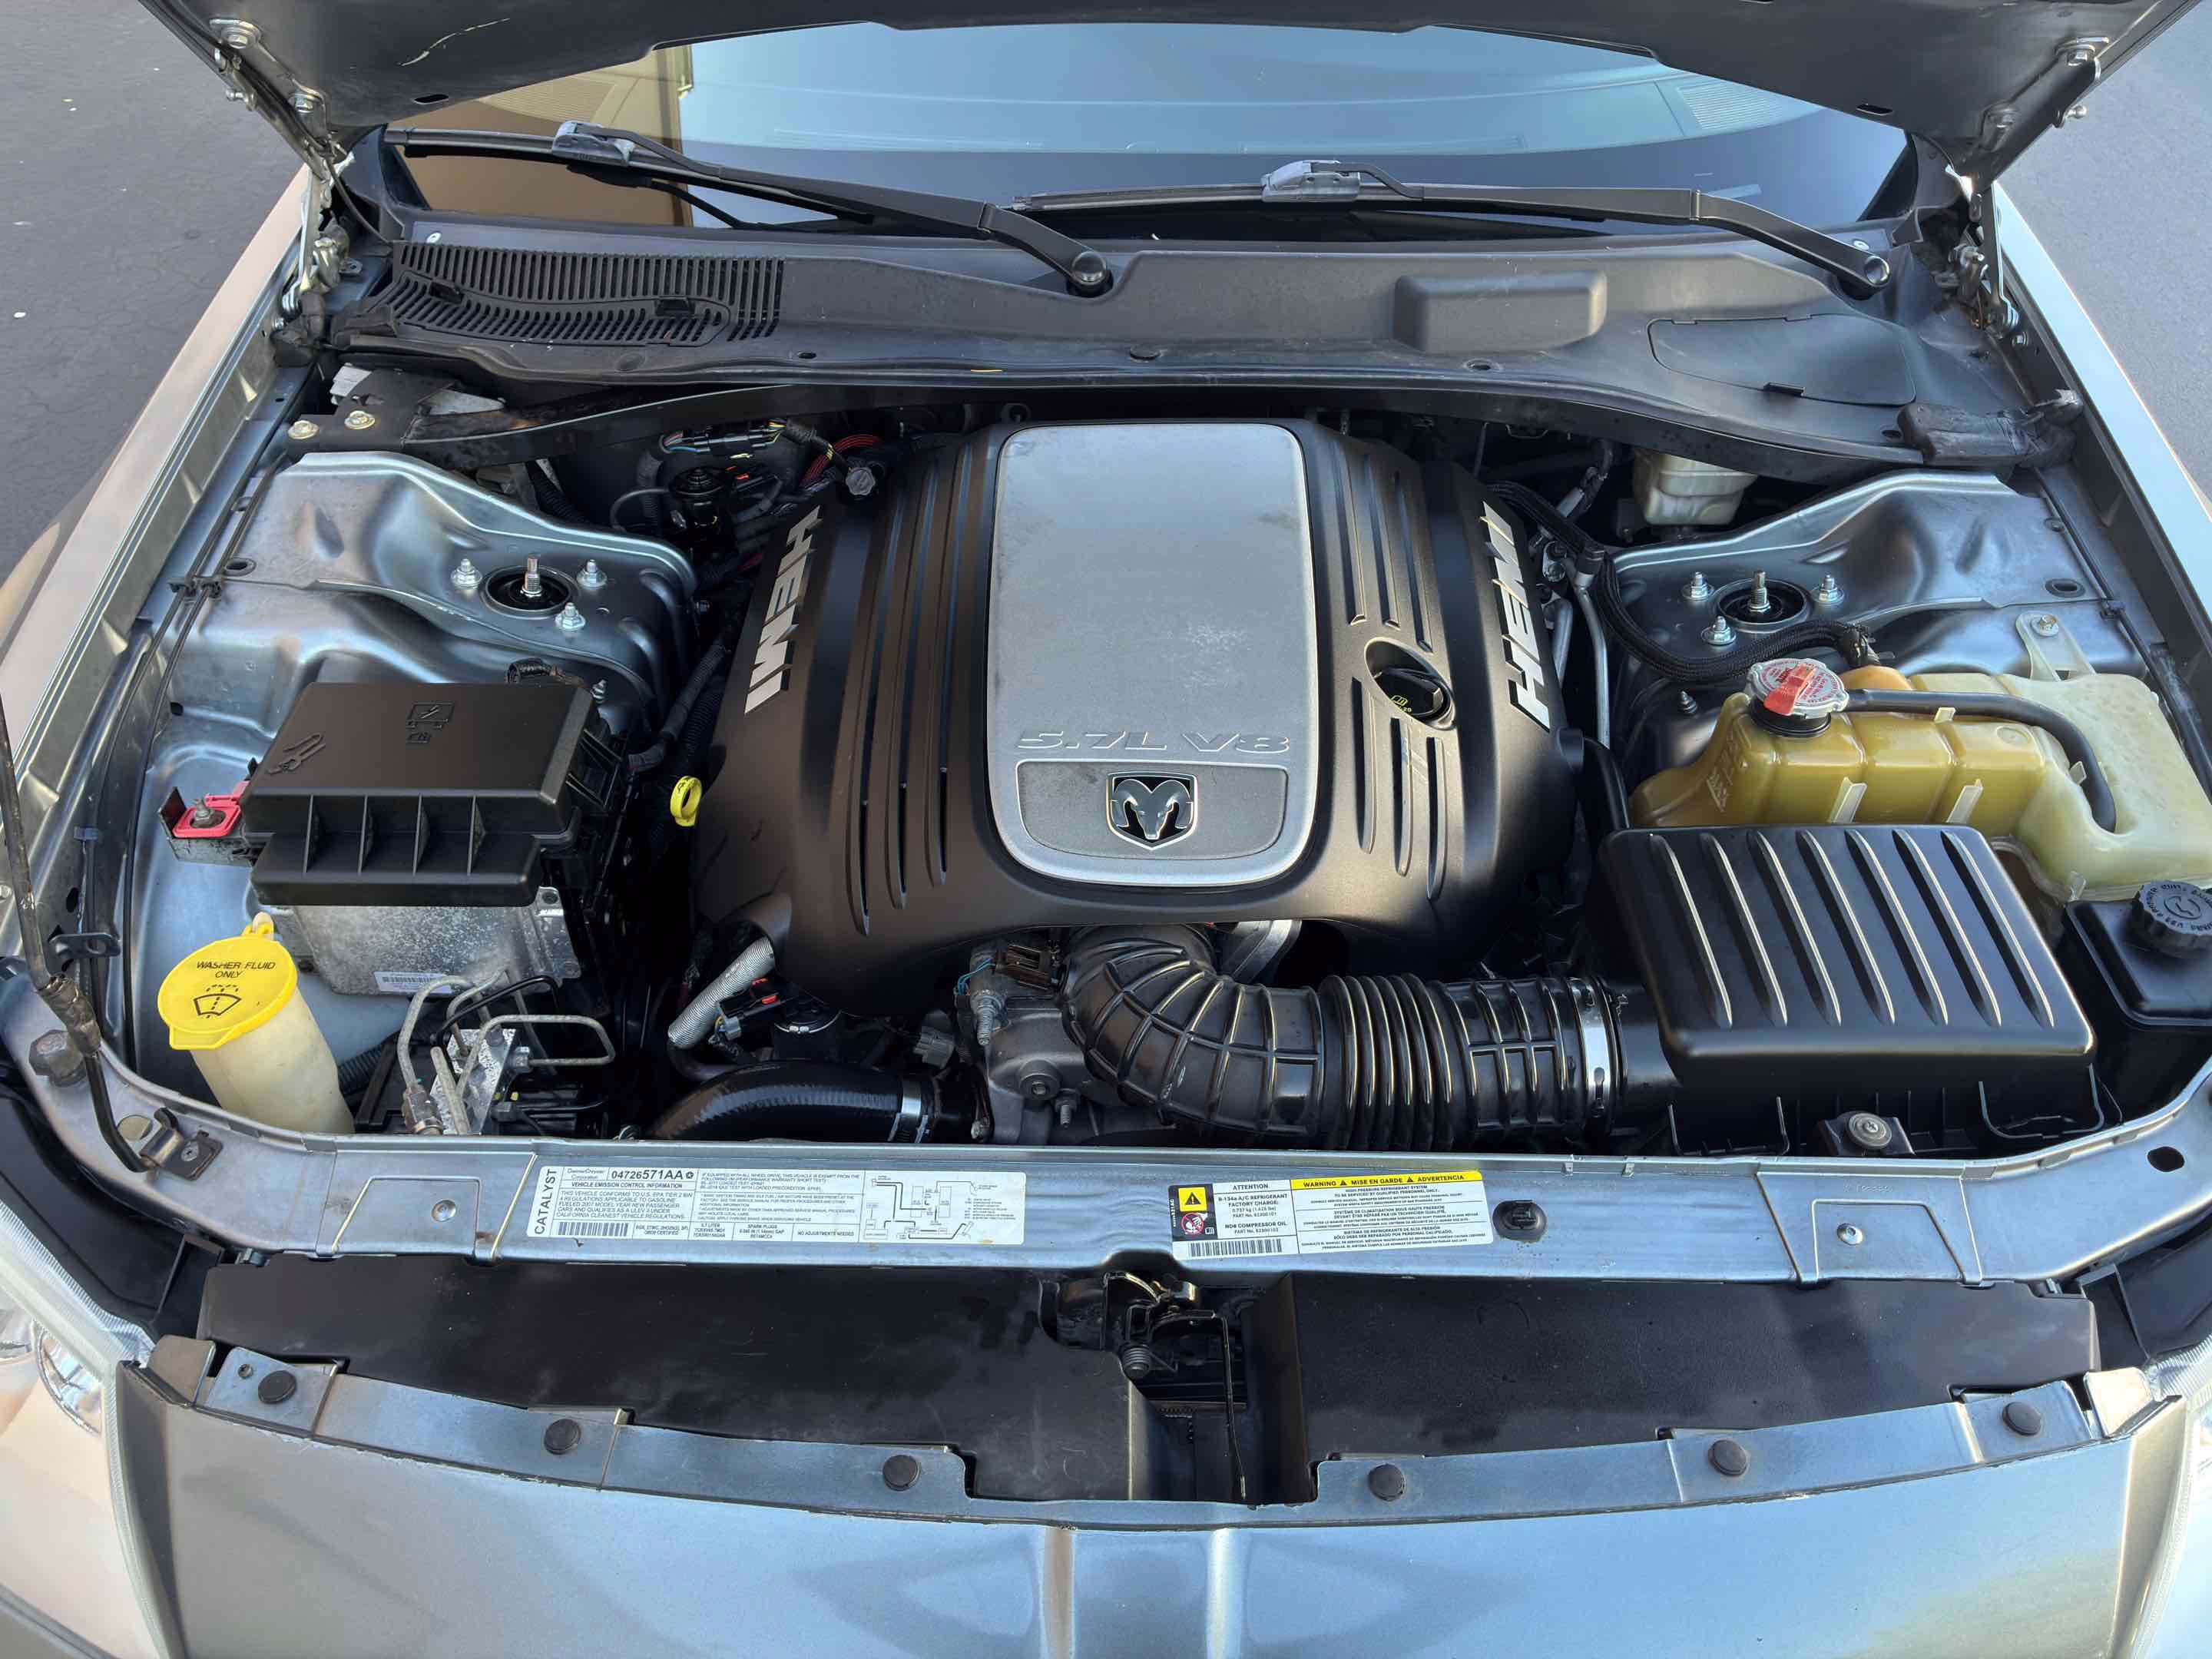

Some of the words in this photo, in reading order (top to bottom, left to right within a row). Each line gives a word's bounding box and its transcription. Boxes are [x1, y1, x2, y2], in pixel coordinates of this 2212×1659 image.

[744, 505, 822, 714] HEMI
[1481, 501, 1550, 733] HEMI
[1016, 730, 1167, 751] 5.7L
[1182, 730, 1290, 753] V8
[196, 961, 242, 970] WASHER
[244, 961, 276, 970] FLUID
[214, 970, 243, 979] ONLY
[611, 1169, 684, 1180] 04726571AA
[534, 1168, 558, 1235] CATALYST
